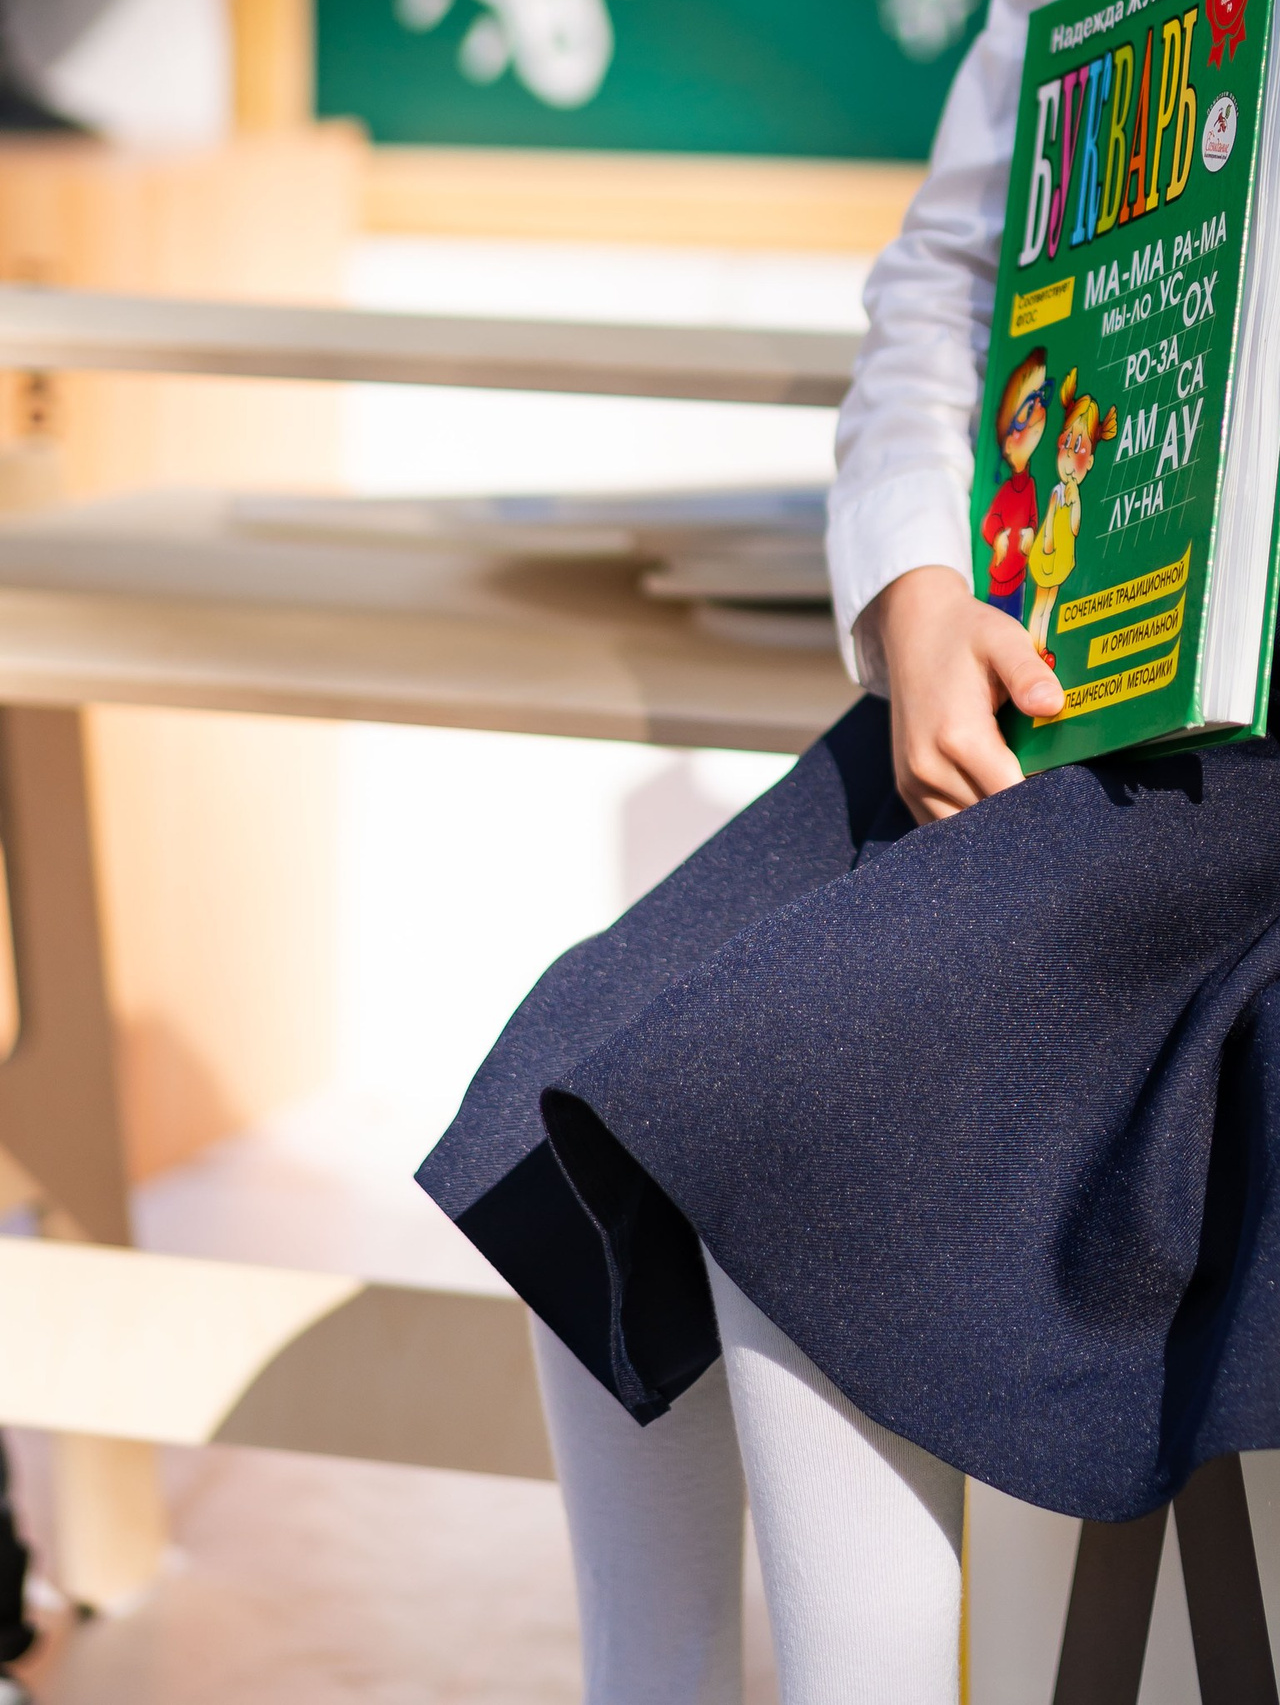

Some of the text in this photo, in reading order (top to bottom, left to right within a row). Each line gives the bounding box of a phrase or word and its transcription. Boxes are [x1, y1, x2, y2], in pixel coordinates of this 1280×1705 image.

[1050, 0, 1125, 54] Надежда
[1018, 6, 1199, 268] БУКВАРЬ
[1084, 210, 1227, 311] МА-МА РА-МА
[1101, 270, 1184, 338] МЫ-ЛО УС
[1182, 270, 1218, 327] ОХ
[1124, 334, 1179, 389] РО-ЗА
[1177, 354, 1204, 399] СА
[1115, 402, 1159, 463] АМ
[1155, 396, 1204, 478] АУ
[1107, 480, 1164, 533] ЛУ-НА
[1063, 560, 1185, 623] СОЧЕТАНИЕ ТРАДИЦИОННОЙ
[1101, 608, 1180, 655] И ОРИГИНАЛЬНОЙ
[1065, 657, 1174, 710] ПЕДИЧЕСКОЙ МЕТОДИКИ
